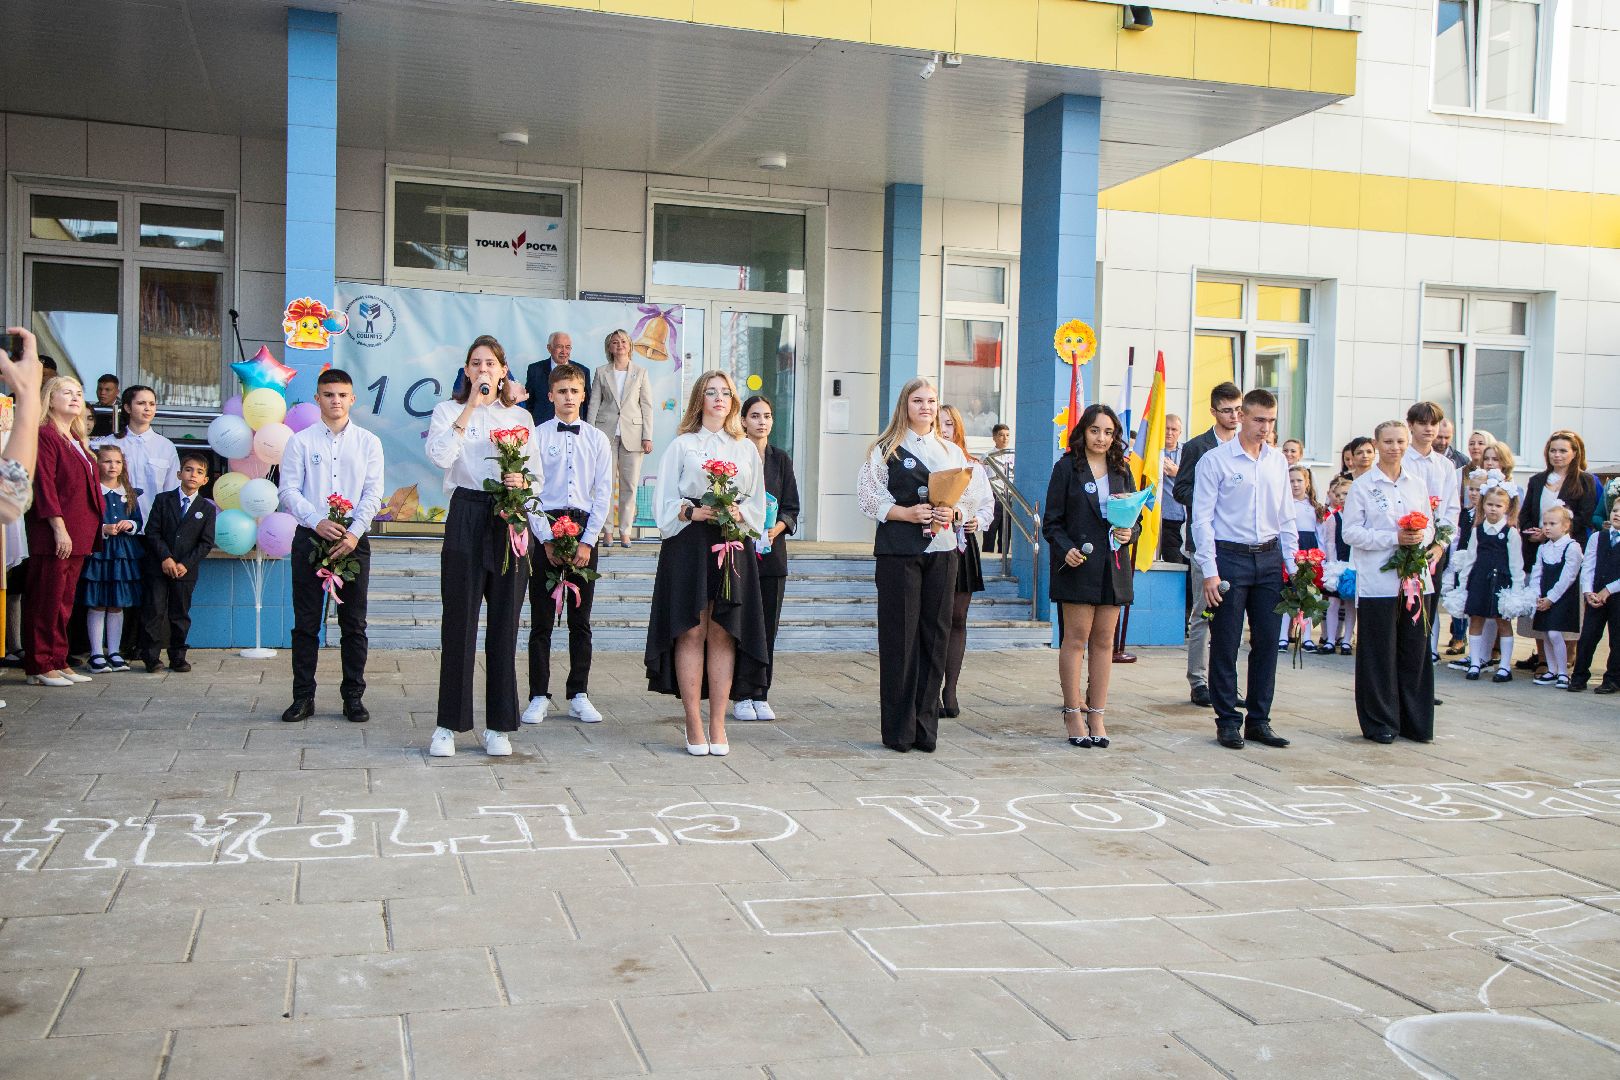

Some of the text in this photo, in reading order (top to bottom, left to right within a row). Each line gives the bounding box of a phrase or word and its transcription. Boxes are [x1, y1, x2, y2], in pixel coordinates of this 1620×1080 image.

[475, 239, 557, 252] ТОЧКА РОСТА
[367, 375, 389, 416] 1
